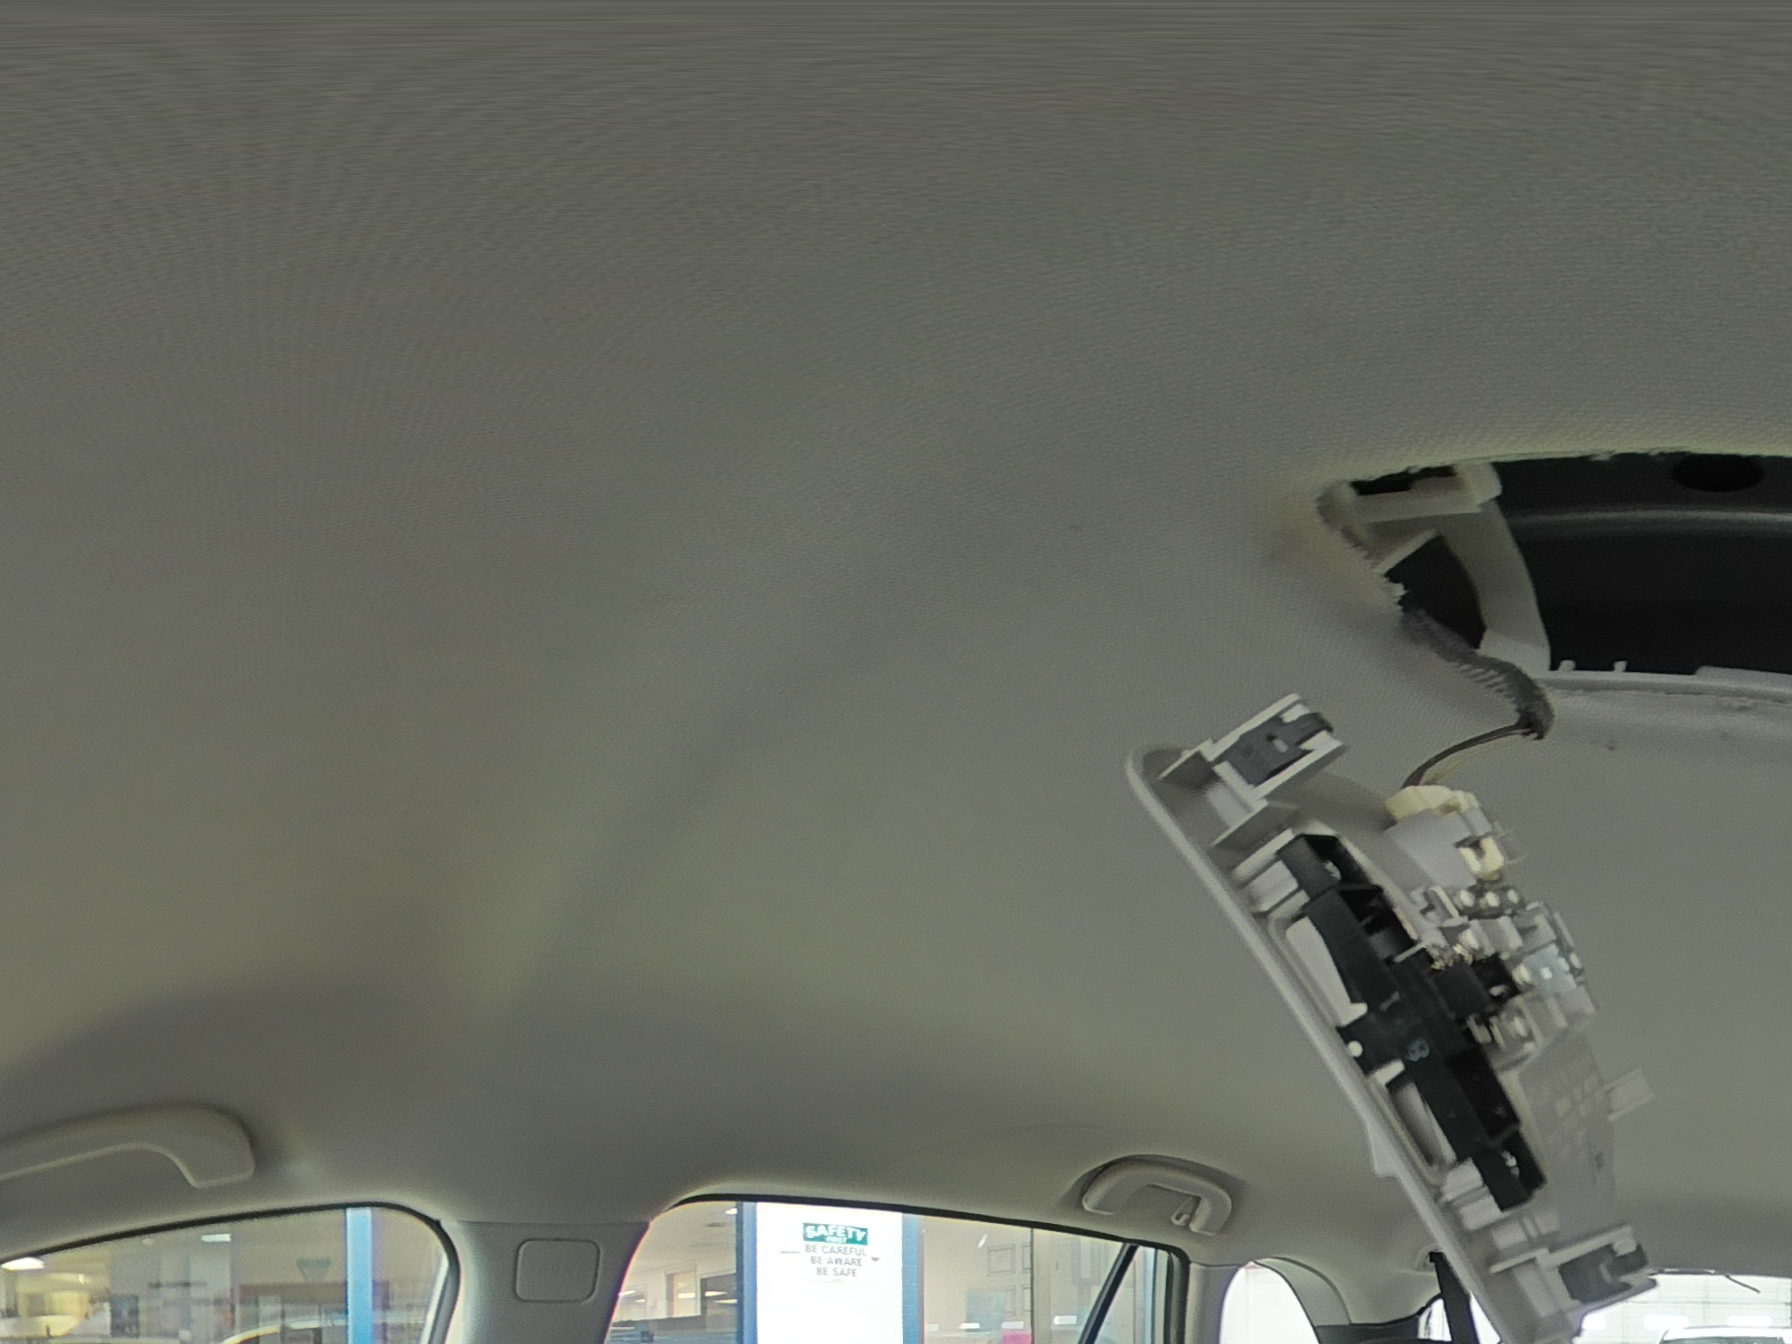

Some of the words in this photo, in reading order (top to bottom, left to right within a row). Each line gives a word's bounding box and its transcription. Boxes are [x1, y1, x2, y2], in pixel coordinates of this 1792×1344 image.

[805, 1225, 866, 1241] SAFETY
[805, 1244, 817, 1253] BE
[822, 1246, 867, 1256] CAREFUL
[810, 1256, 822, 1264] BE
[827, 1257, 862, 1267] AWARE
[816, 1267, 828, 1275] BE
[833, 1268, 857, 1277] SAFE
